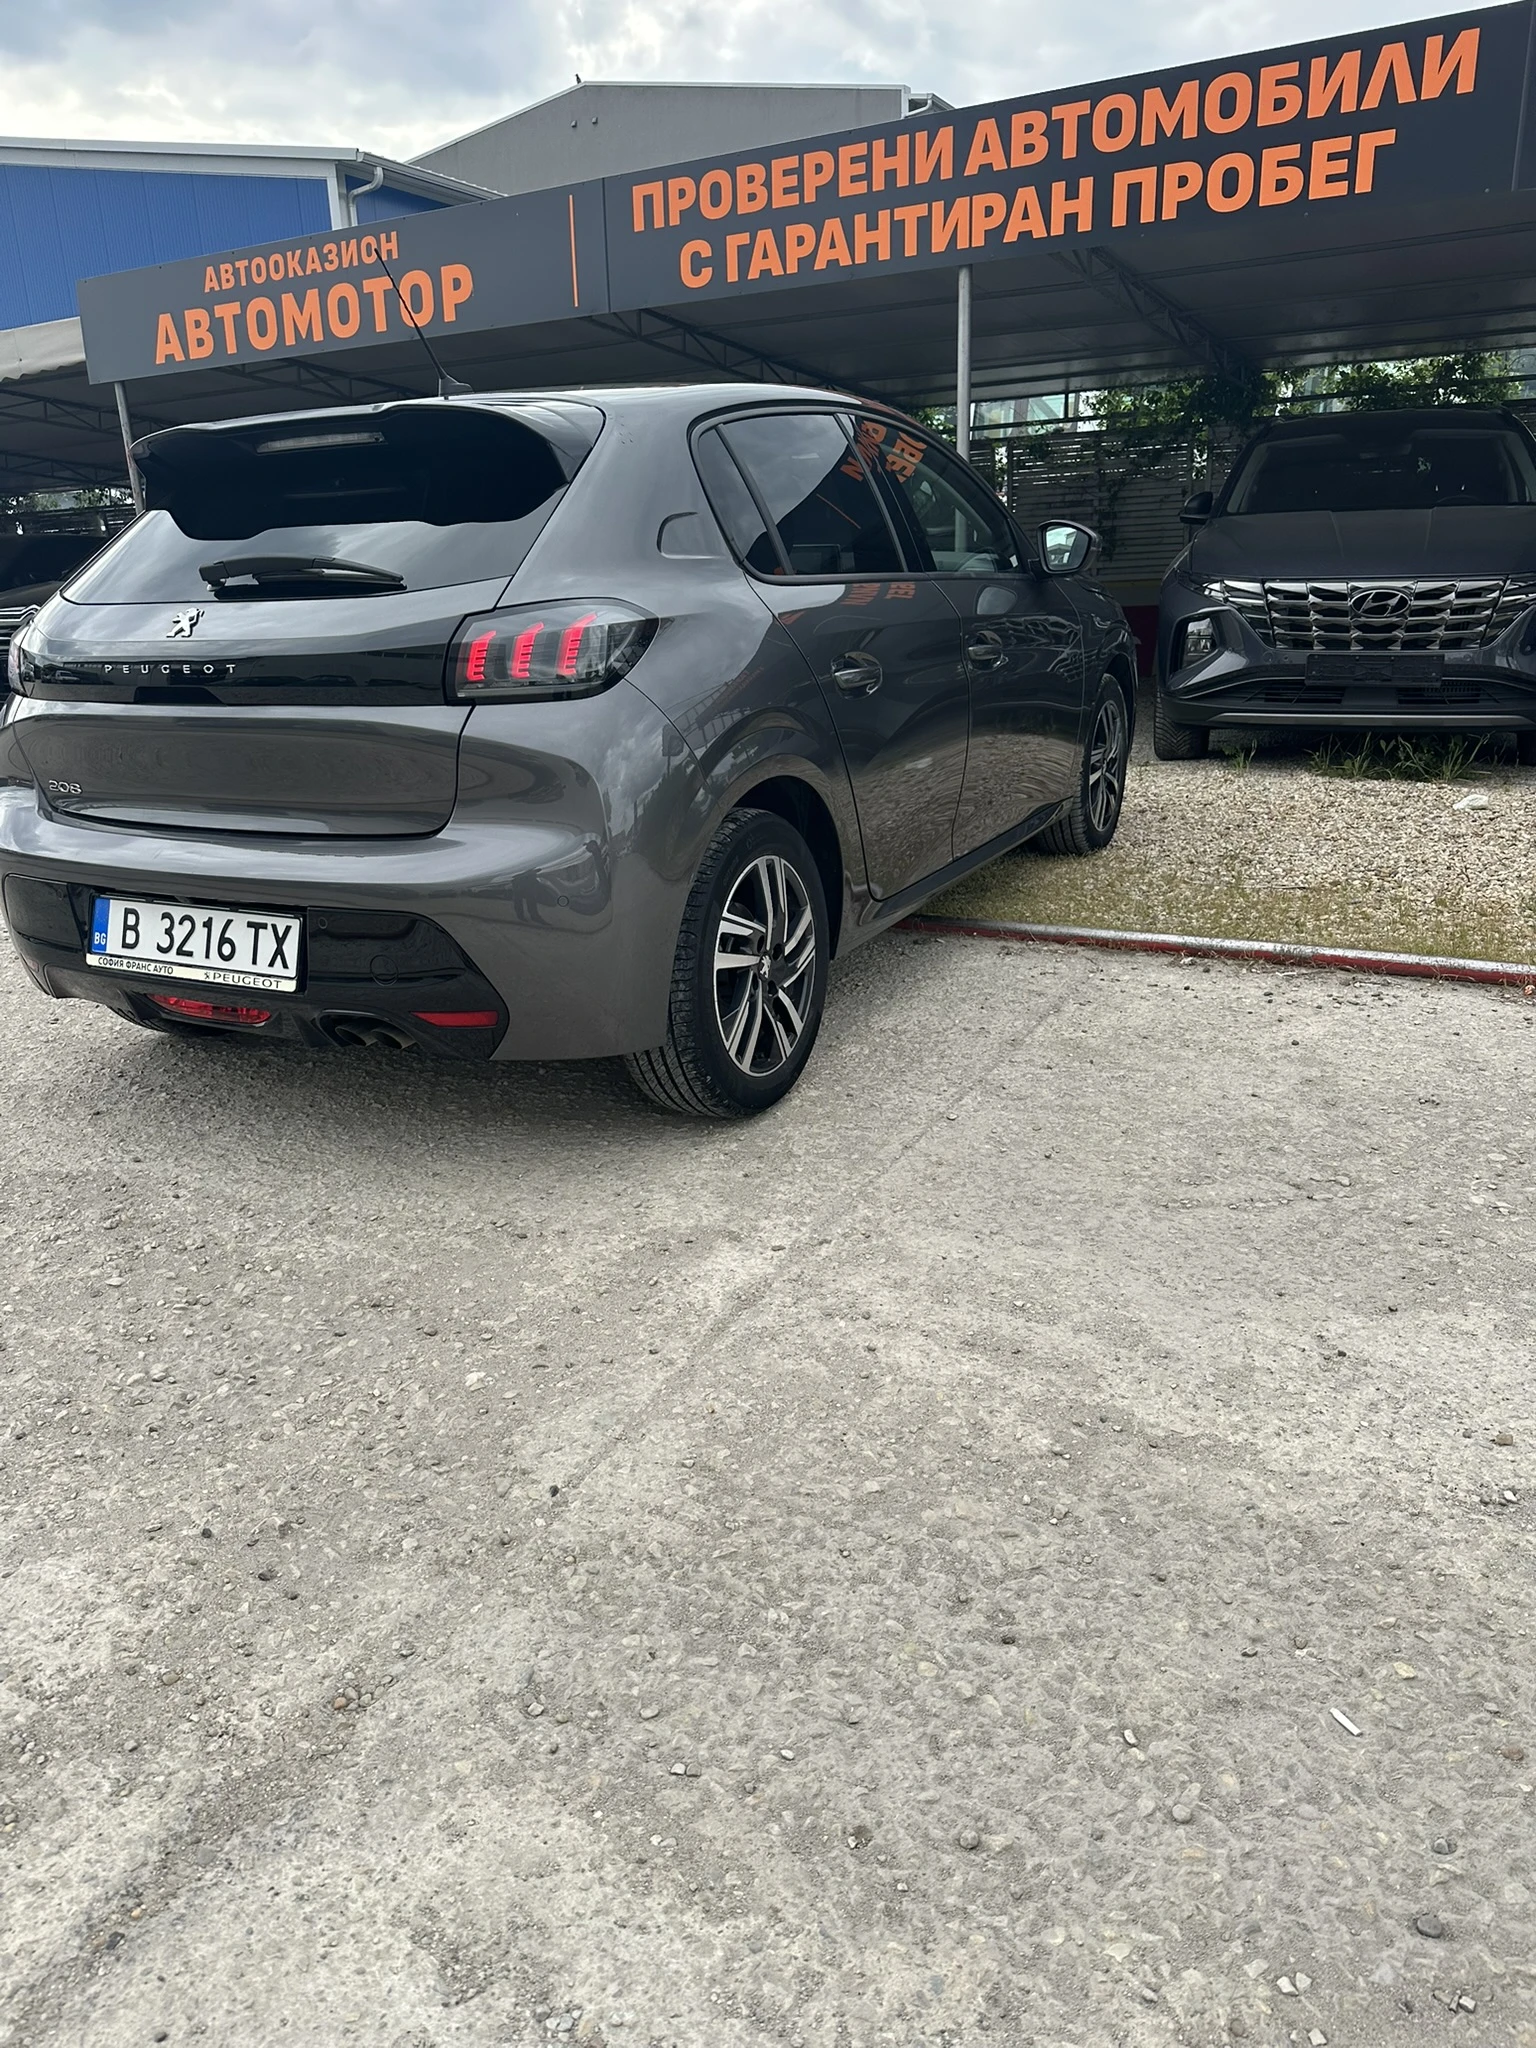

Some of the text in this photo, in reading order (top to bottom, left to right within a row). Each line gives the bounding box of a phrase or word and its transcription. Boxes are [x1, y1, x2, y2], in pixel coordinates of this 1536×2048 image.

[632, 28, 1481, 233] ПРОВЕРЕНИ АВТОМОБИЛИ
[679, 128, 1397, 289] С ГАРАНТИРАН ПРОБЕГ
[204, 231, 399, 292] АВТООКАЗИОН
[155, 263, 474, 364] АВТОМОТОР
[104, 664, 236, 675] PEUGEOT
[48, 779, 83, 795] 208
[94, 932, 107, 945] BG
[156, 912, 236, 962] 3216
[97, 956, 174, 975] СОФИЯ ФРАНС АУТО
[213, 972, 282, 989] PEUGEOT
